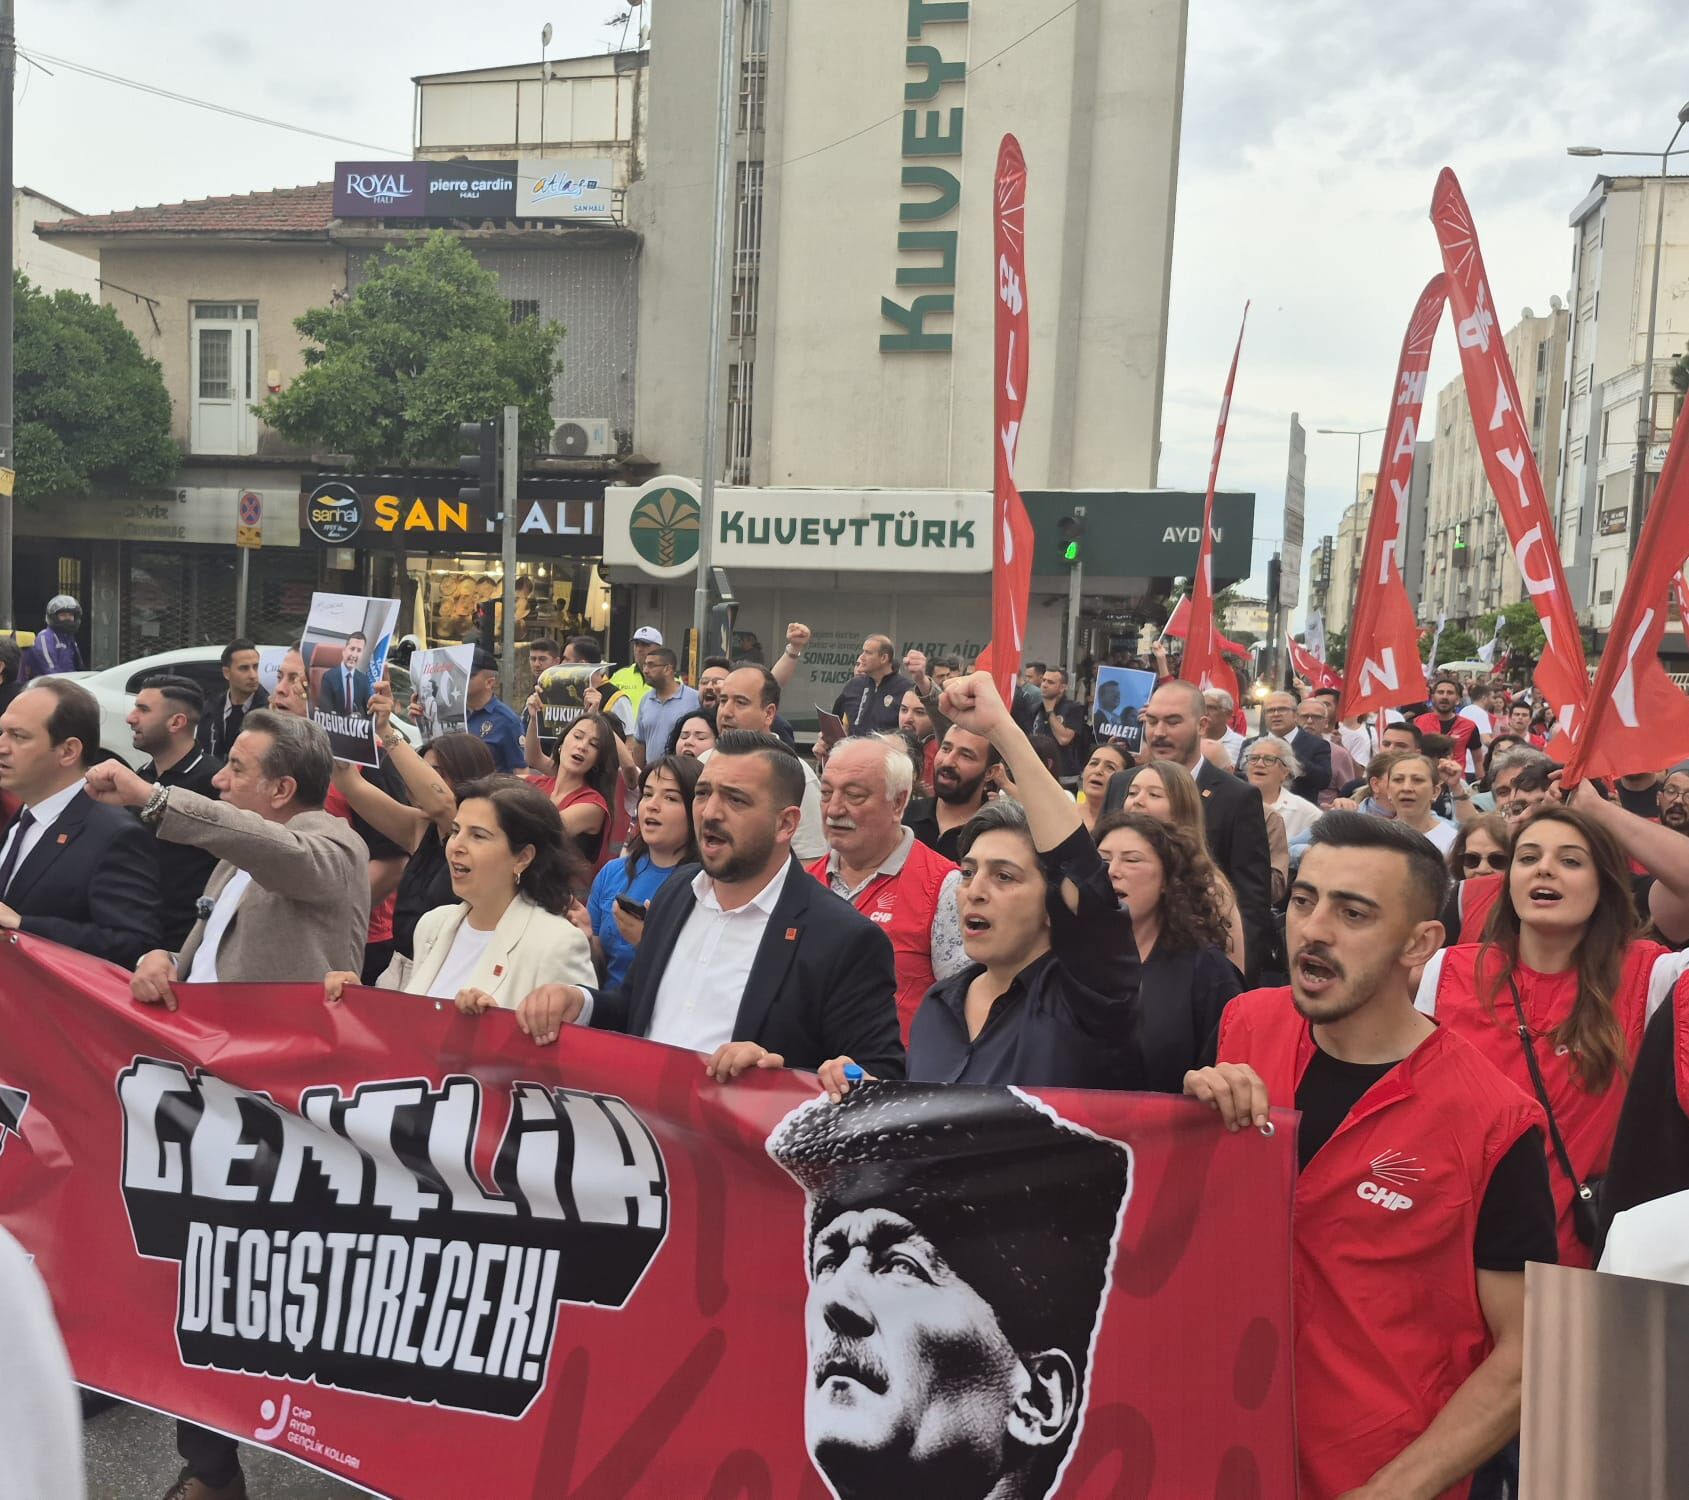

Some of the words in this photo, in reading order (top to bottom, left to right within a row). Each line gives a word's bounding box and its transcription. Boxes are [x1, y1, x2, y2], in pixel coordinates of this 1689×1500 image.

[346, 174, 413, 199] ROYAL
[430, 178, 468, 193] pierre
[471, 178, 512, 191] cardin
[459, 191, 480, 199] HALI
[532, 172, 584, 202] atlas
[374, 495, 468, 532] ŞAN
[486, 501, 594, 535] ALI
[803, 652, 859, 666] SONRADA
[314, 707, 369, 739] ÖZGÜRLÜK!
[1099, 722, 1138, 740] ADALET!
[1356, 1181, 1413, 1212] CHP
[292, 1406, 312, 1420] CHP
[289, 1418, 316, 1437] AYDIN
[287, 1431, 324, 1452] GENÇLİK
[324, 1446, 360, 1469] KOLLARI
